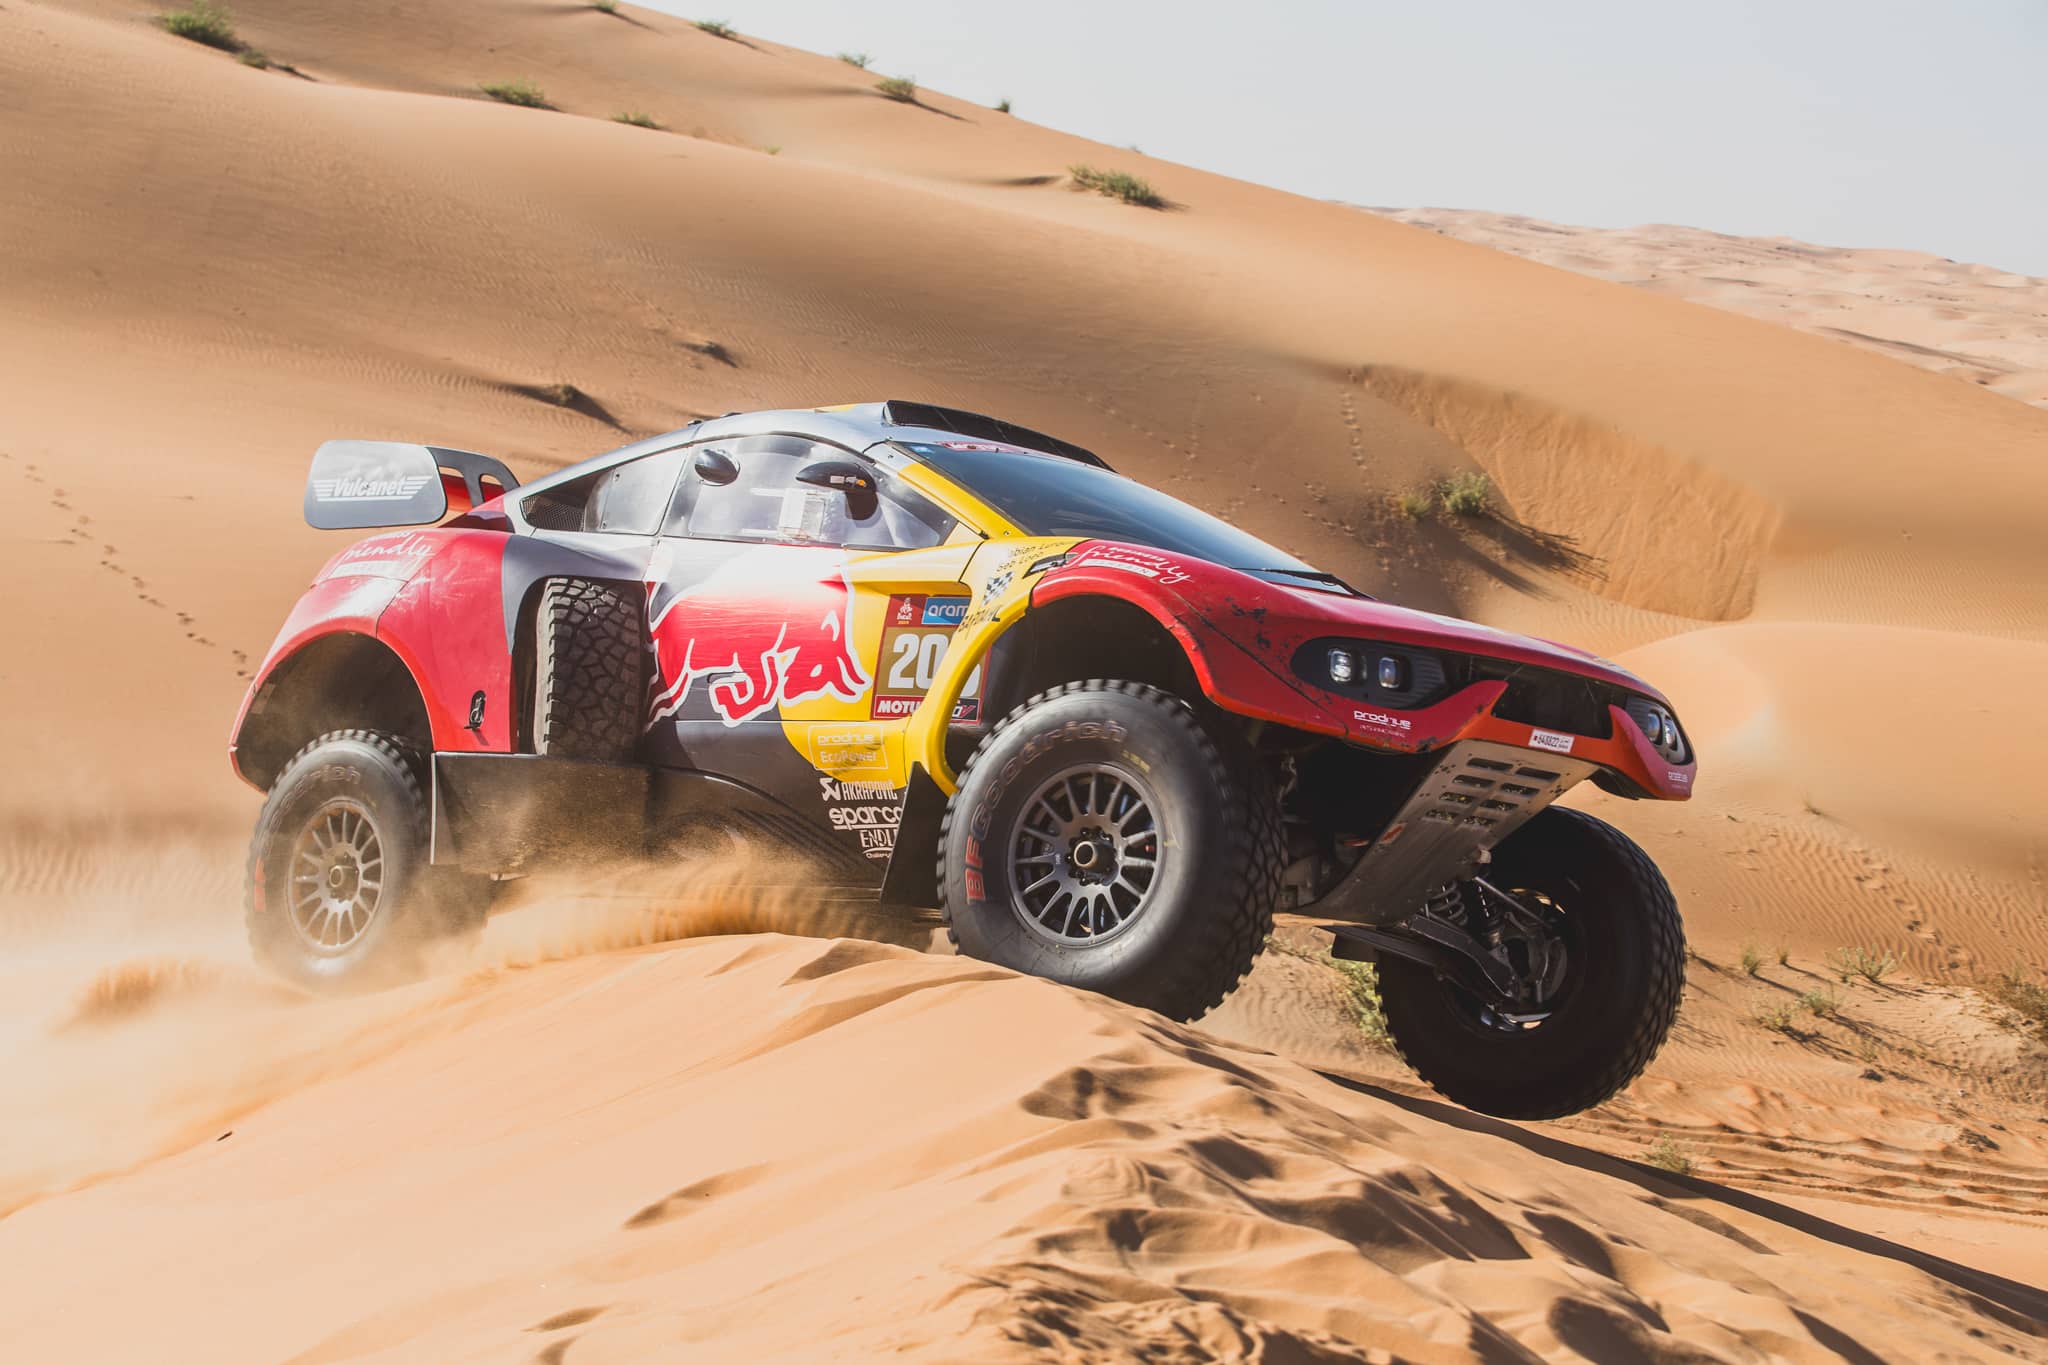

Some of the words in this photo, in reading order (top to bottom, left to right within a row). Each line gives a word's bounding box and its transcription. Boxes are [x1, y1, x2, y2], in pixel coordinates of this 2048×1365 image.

[333, 476, 407, 497] Vulcanet
[1062, 545, 1192, 584] friendly
[928, 604, 969, 617] aram
[877, 700, 921, 714] MOTU
[1353, 710, 1412, 730] prodrive
[820, 750, 877, 764] EcoPower
[860, 828, 897, 849] ENDL
